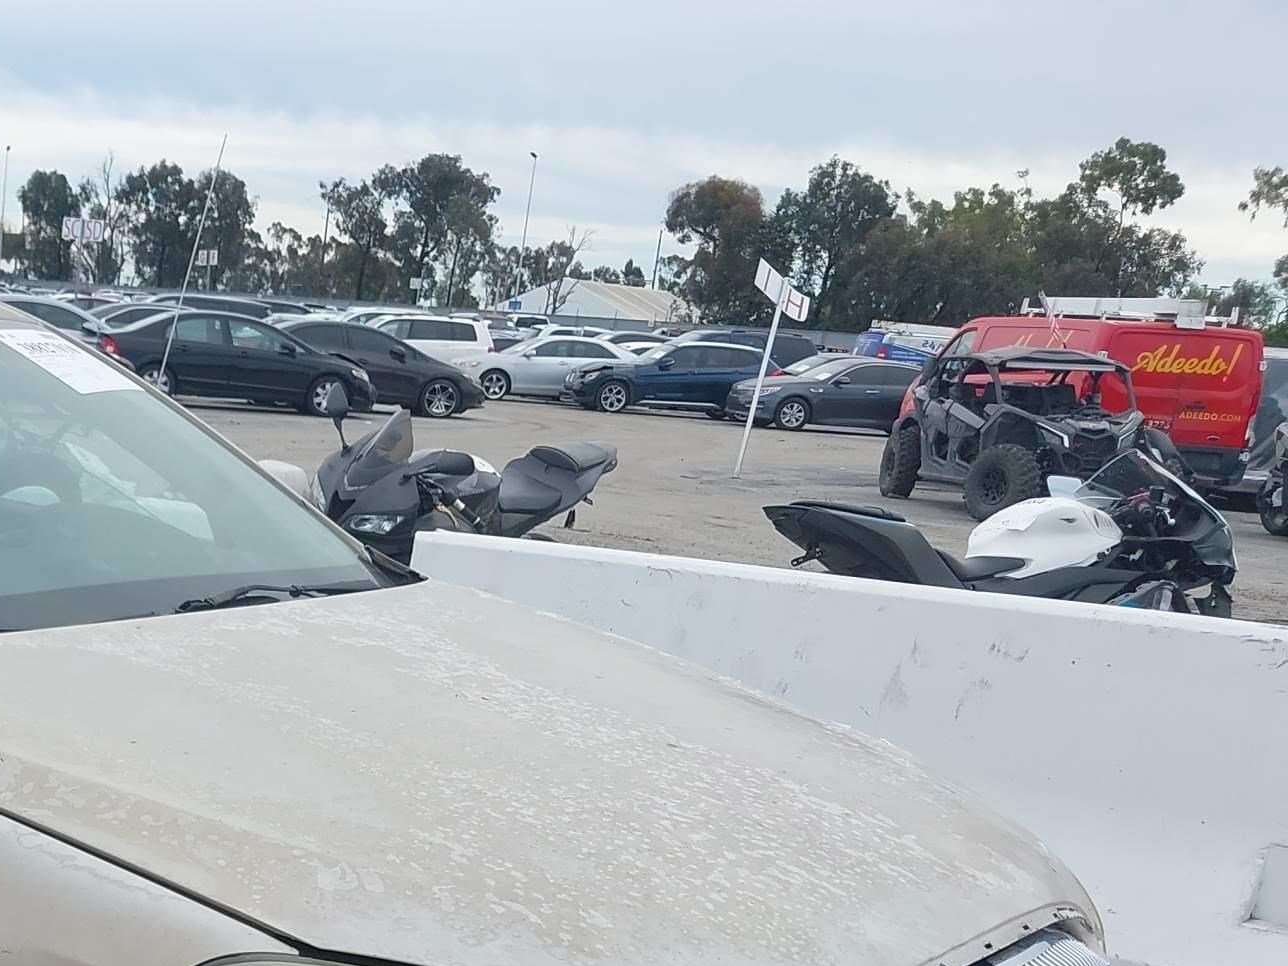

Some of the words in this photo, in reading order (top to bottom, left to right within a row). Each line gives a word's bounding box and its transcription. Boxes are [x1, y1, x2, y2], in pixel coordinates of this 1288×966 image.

[63, 219, 81, 239] SC
[86, 220, 103, 240] SD
[784, 288, 805, 320] H
[1130, 343, 1244, 383] Adeedo!
[1179, 411, 1241, 423] ADEEDO.COM
